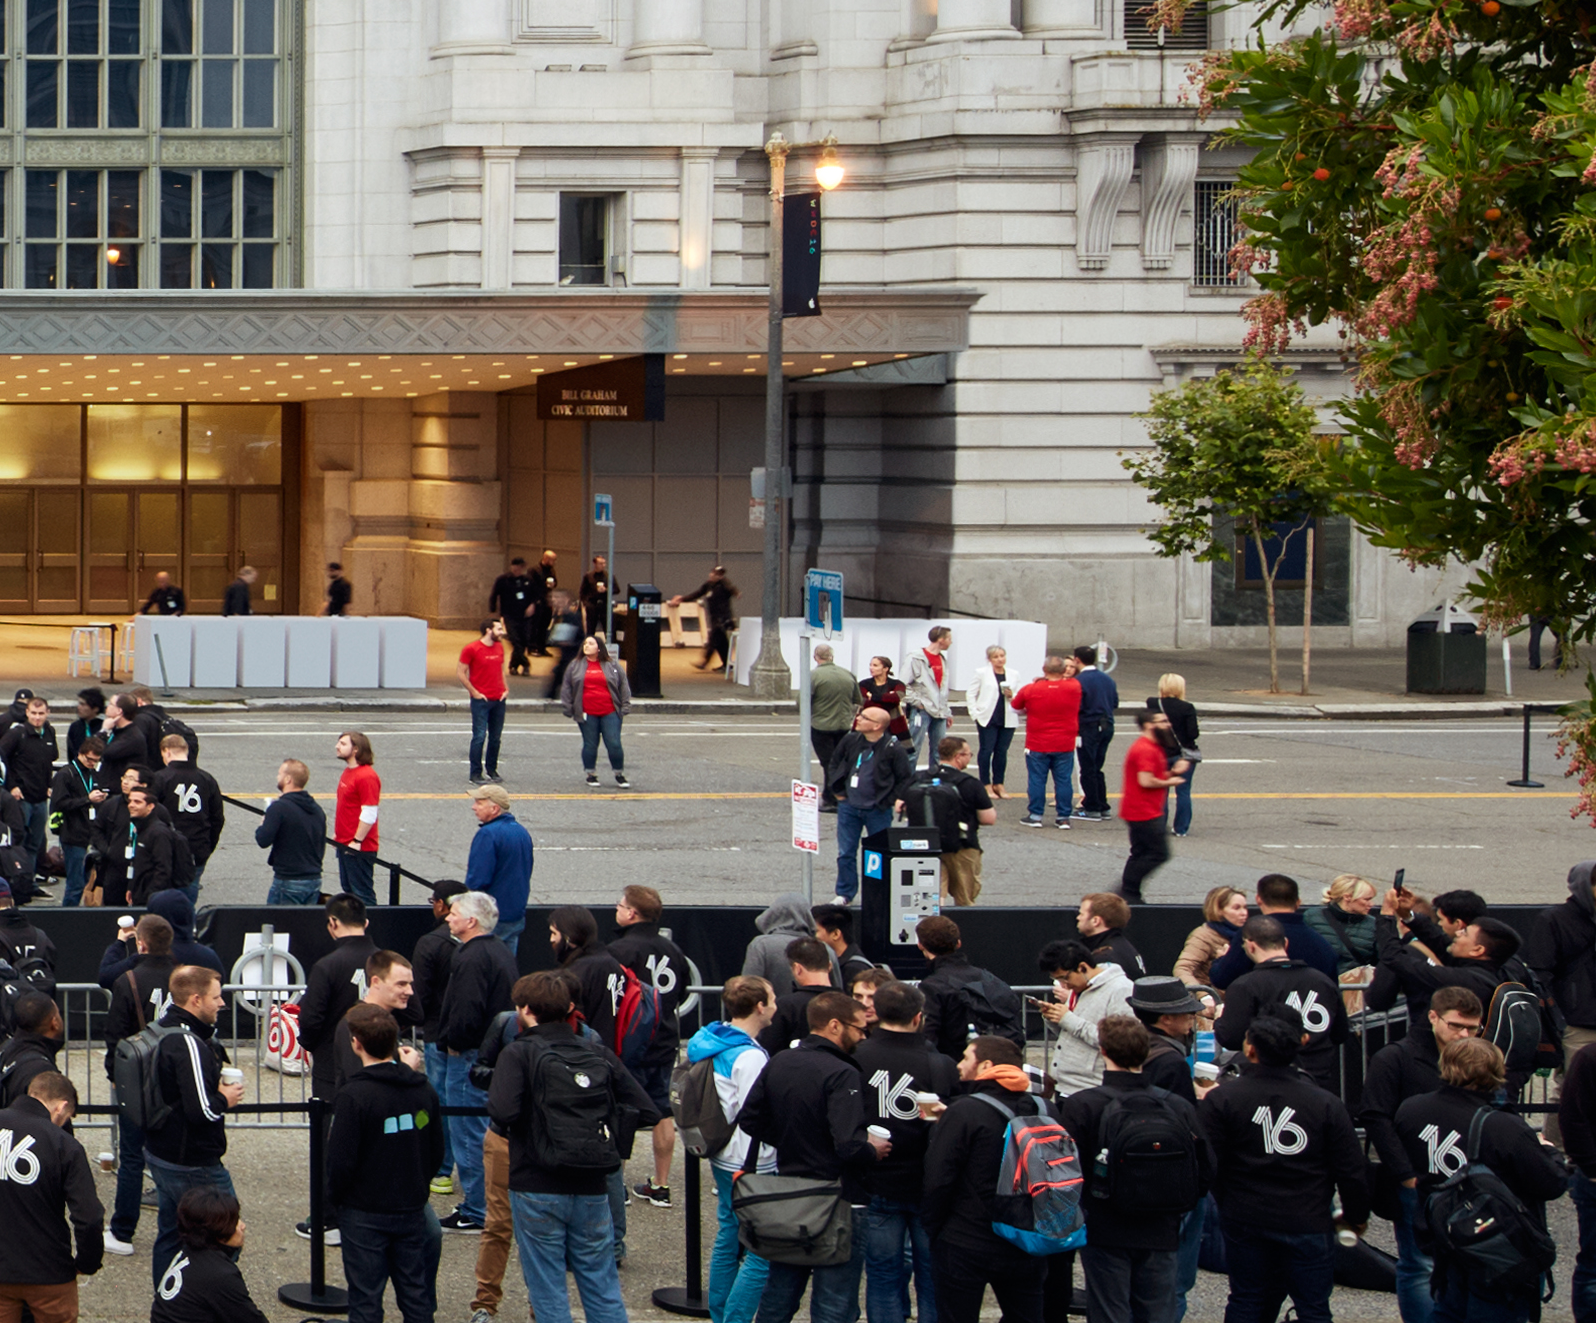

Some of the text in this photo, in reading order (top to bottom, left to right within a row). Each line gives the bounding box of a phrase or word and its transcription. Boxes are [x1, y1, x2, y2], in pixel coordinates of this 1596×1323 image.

[551, 404, 628, 417] CIVIC AUDITORIUM
[562, 389, 618, 401] BILL GRAHAM
[810, 573, 841, 591] PAY HERE
[173, 783, 202, 814] 16
[645, 954, 676, 995] 16
[867, 1069, 920, 1120] 16
[1251, 1105, 1307, 1154] 16
[1418, 1123, 1468, 1177] 16
